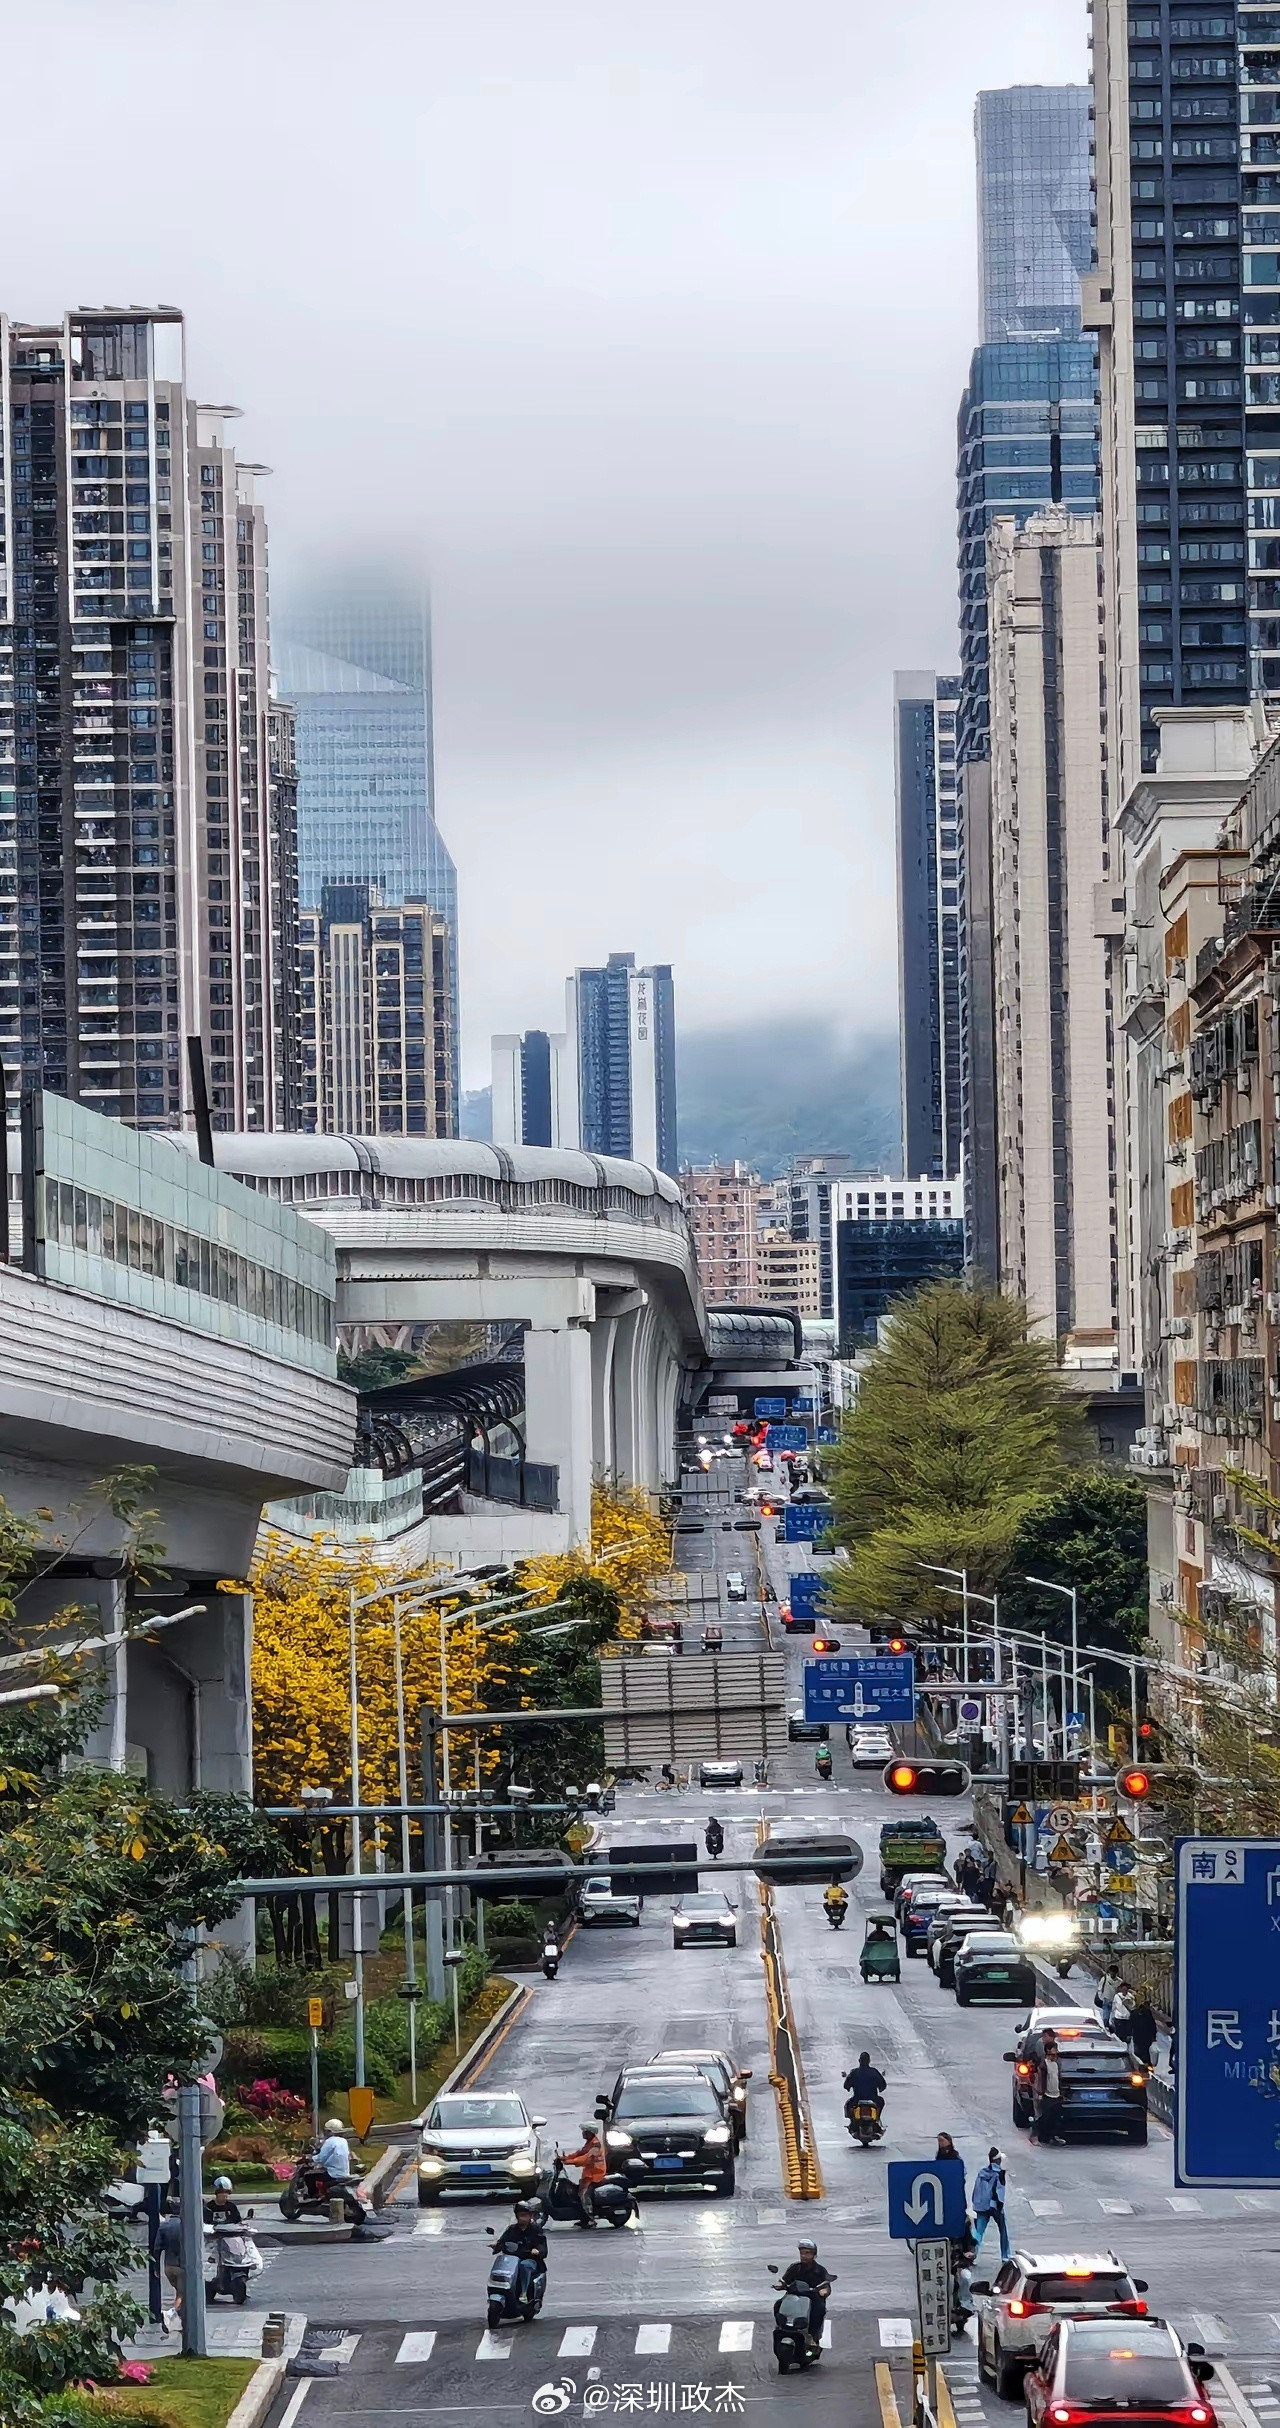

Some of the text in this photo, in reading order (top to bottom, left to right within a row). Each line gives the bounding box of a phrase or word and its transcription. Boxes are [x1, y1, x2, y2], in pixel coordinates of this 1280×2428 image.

[1053, 1812, 1070, 1828] 15
[1191, 1850, 1218, 1879] 南
[1224, 1849, 1238, 1866] S
